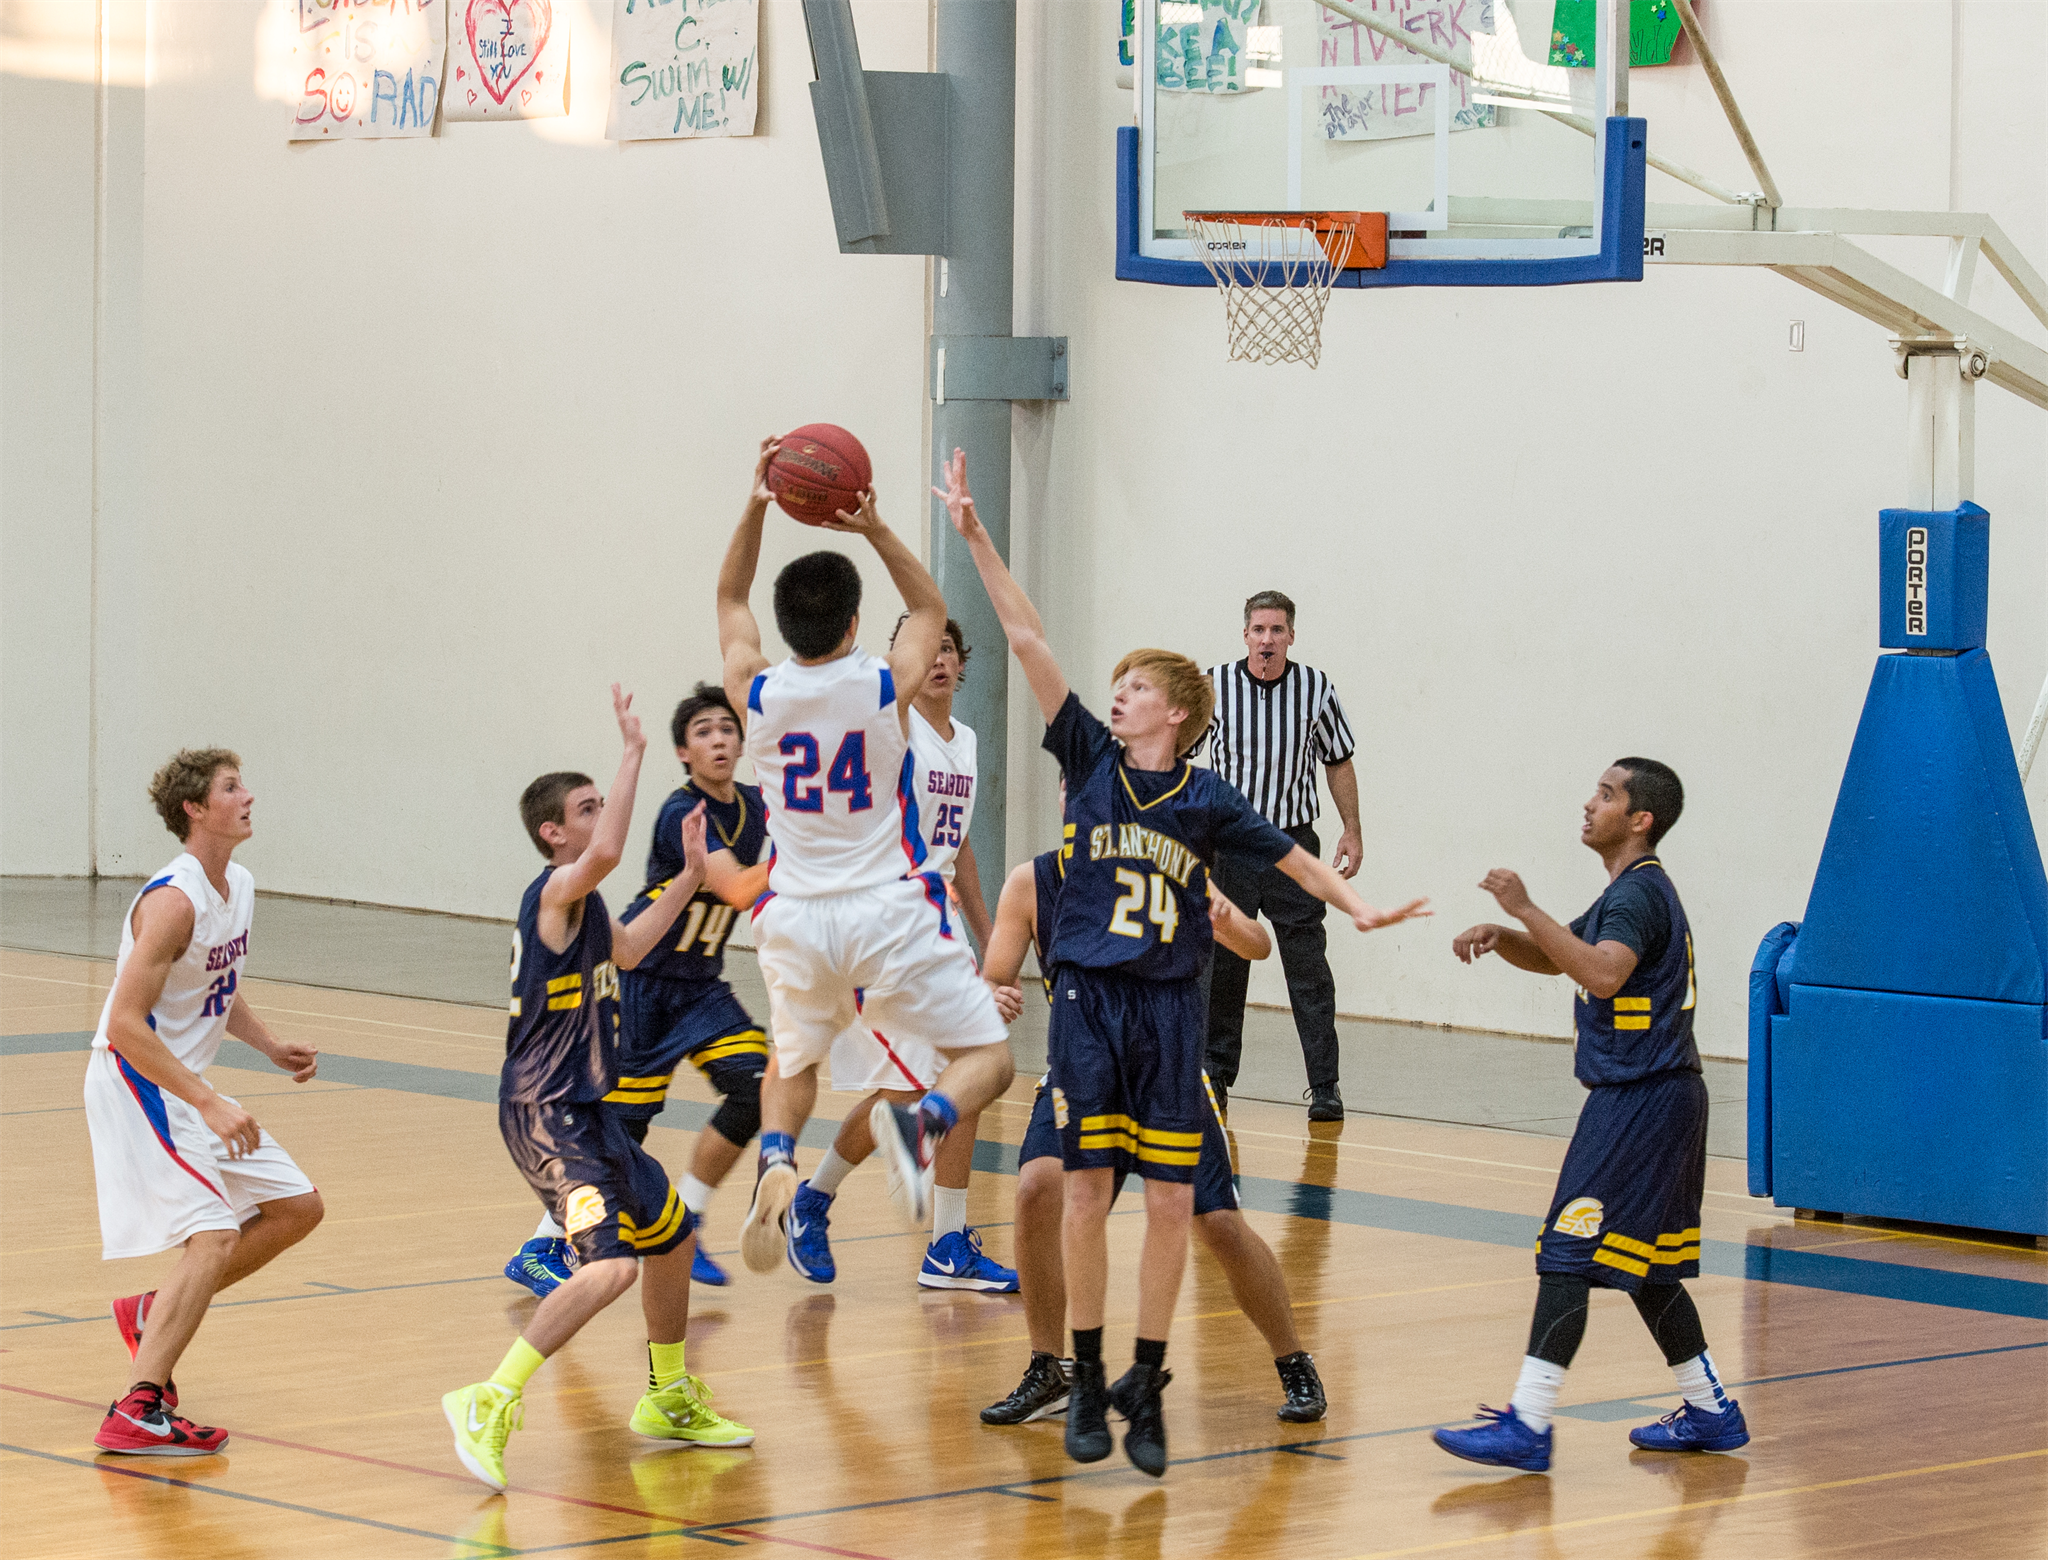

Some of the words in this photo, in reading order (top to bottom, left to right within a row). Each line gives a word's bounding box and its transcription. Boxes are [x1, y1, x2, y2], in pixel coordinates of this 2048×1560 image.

[344, 20, 377, 63] IS
[295, 67, 356, 125] SO
[370, 67, 437, 129] RAD
[1157, 55, 1239, 93] BEE!
[673, 88, 729, 133] ME!
[778, 730, 872, 813] 24
[931, 803, 964, 848] 25
[674, 901, 734, 957] 14
[1109, 866, 1179, 943] 24
